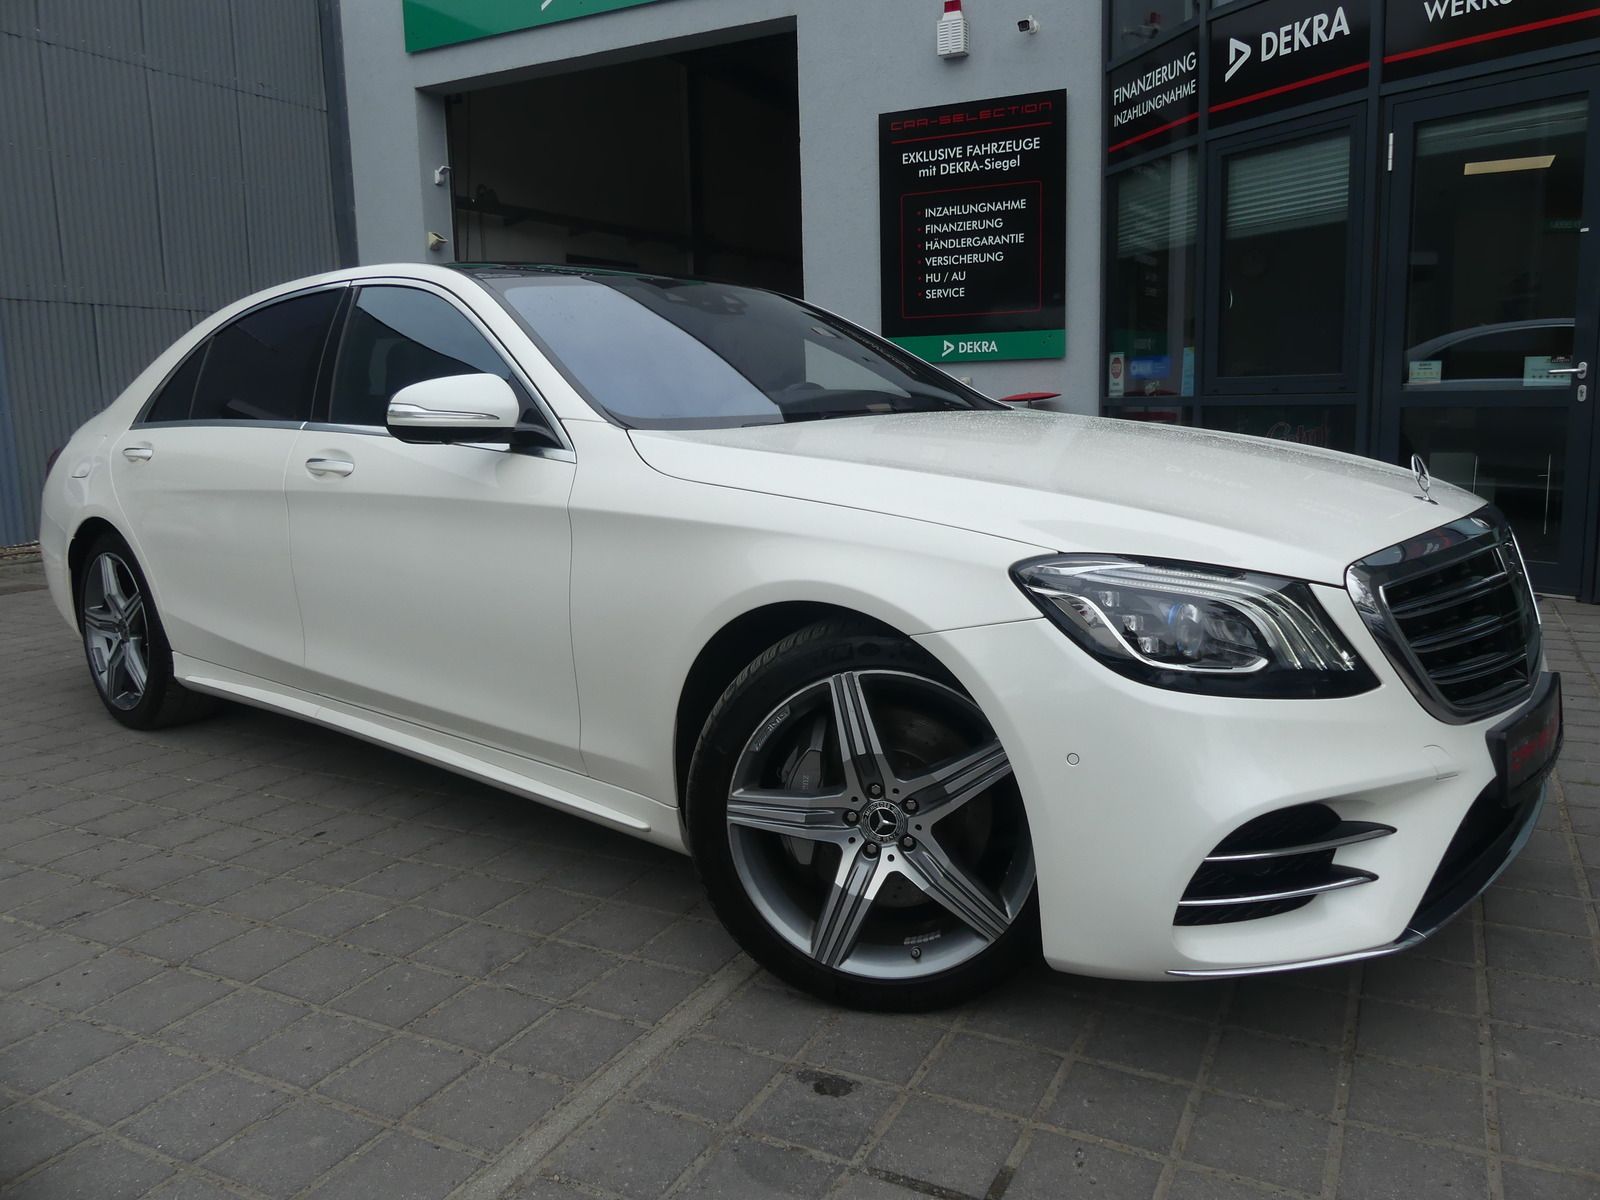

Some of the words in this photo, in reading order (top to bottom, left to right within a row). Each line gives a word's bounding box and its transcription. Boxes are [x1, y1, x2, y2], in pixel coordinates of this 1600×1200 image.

[1260, 6, 1351, 62] DEKRA
[1113, 51, 1197, 106] FINANZIERUNG
[1113, 78, 1197, 128] INZAHLUNGNAHME
[890, 100, 1053, 131] CAR-SELECTION
[902, 146, 963, 164] EXKLUSIVE
[966, 137, 1040, 157] FAHRZEUGE
[918, 166, 937, 178] mit
[940, 155, 1020, 176] DEKRA-Siegel
[925, 199, 1027, 218] INZAHLUNGNAHME
[925, 218, 1004, 235] FINANZIERUNG
[925, 232, 1025, 251] HÄNDLERGARANTIE
[925, 251, 1004, 267] VERSICHERUNG
[925, 273, 941, 283] HU
[951, 271, 966, 281] AU
[925, 287, 965, 300] SERVICE
[958, 340, 998, 355] DEKRA
